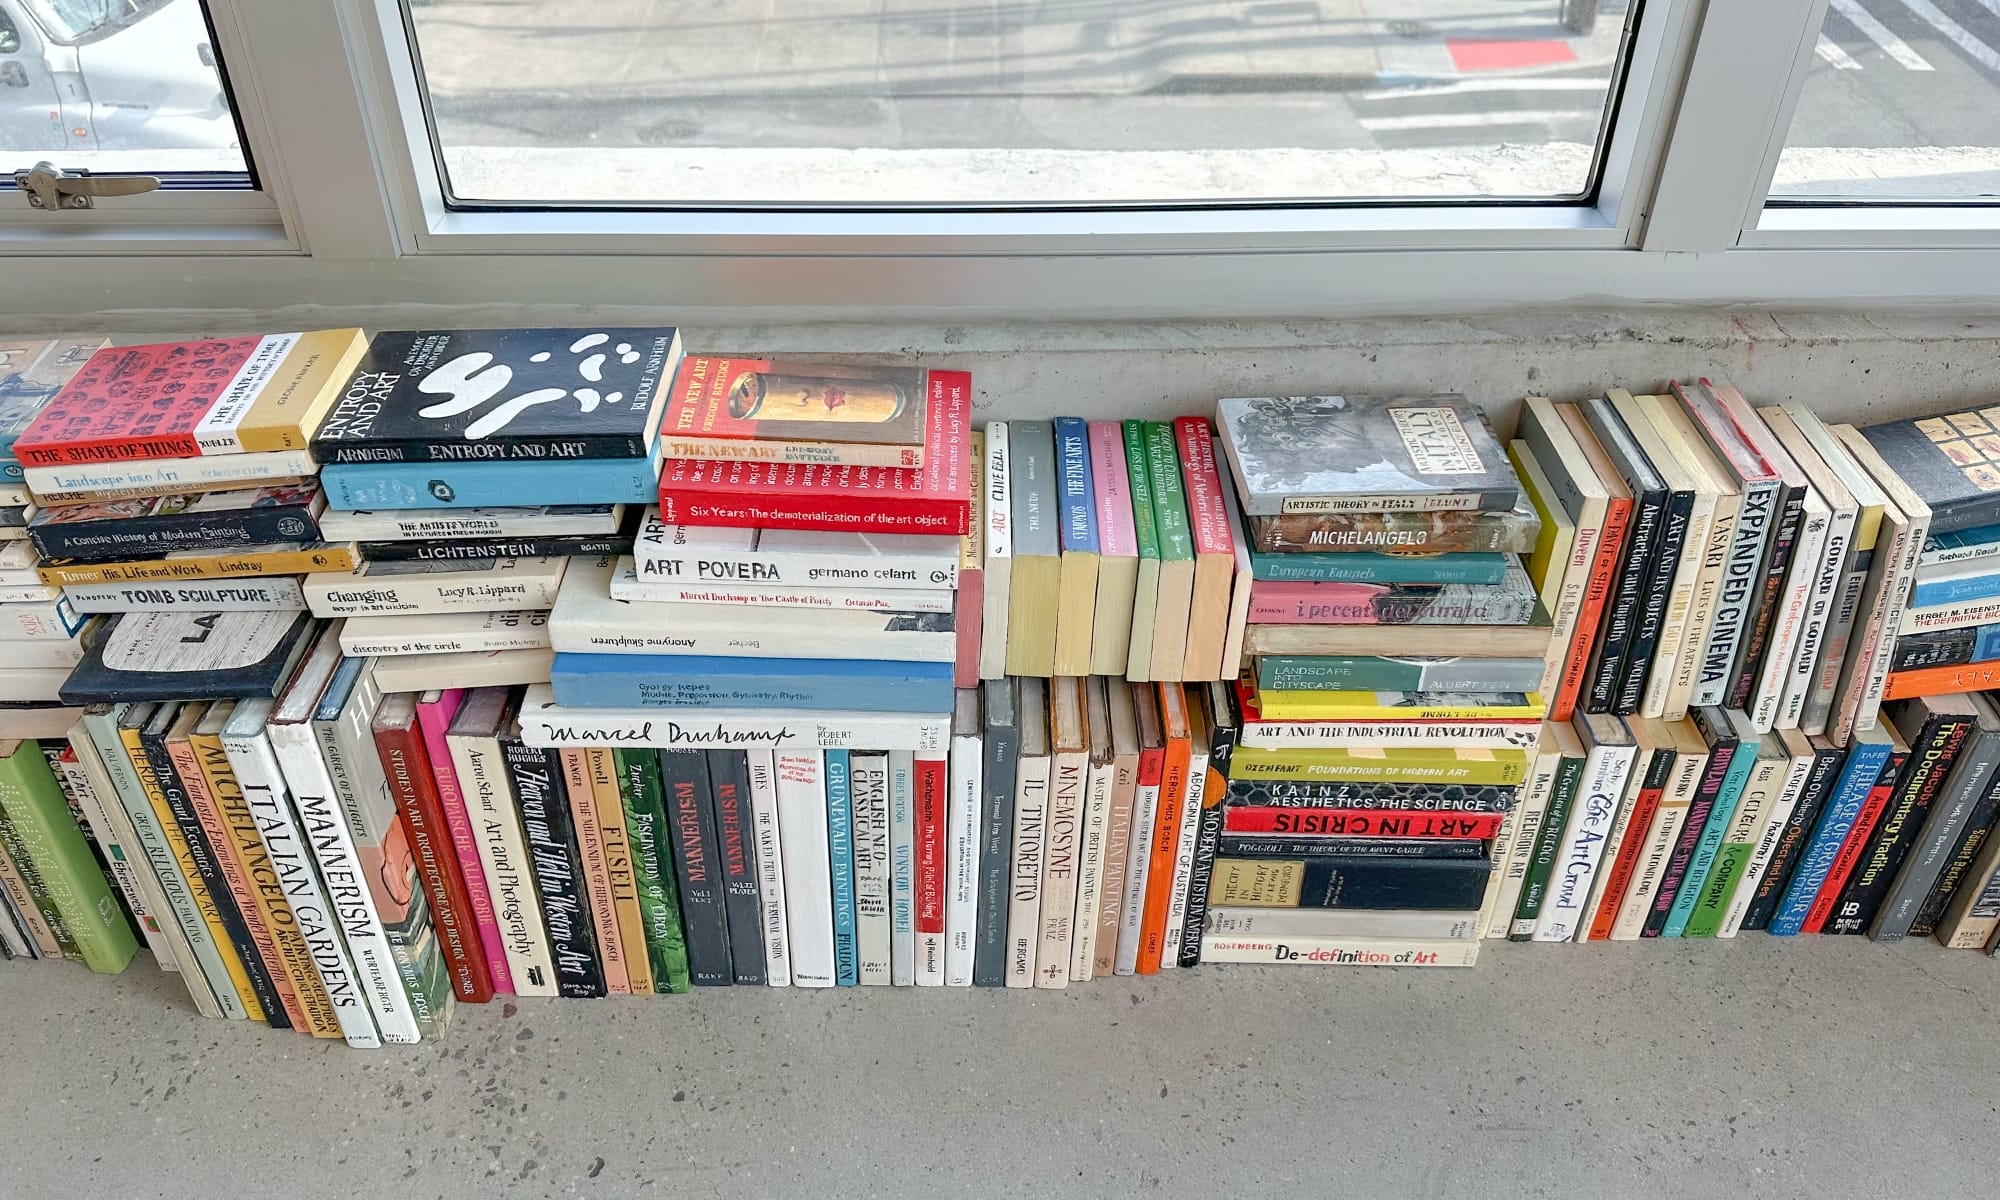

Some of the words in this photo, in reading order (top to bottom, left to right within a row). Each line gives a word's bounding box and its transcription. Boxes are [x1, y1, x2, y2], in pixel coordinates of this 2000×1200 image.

[319, 371, 378, 441] ENTROPY
[348, 400, 384, 438] AND
[377, 371, 401, 401] ART
[26, 449, 64, 464] THE
[69, 444, 118, 461] SHAPE
[118, 442, 139, 457] OF
[137, 439, 194, 456] THINGS
[336, 448, 404, 462] ARNHEIM
[427, 443, 506, 460] ENTROPY
[511, 444, 546, 458] AND
[550, 442, 587, 457] ART
[53, 474, 124, 489] Landscape
[157, 469, 179, 483] Art
[690, 506, 709, 518] Six
[711, 506, 747, 518] Years:
[748, 507, 769, 519] The
[770, 508, 862, 523] dematerialization
[864, 513, 877, 523] of
[877, 513, 895, 524] the
[896, 514, 912, 524] art
[915, 513, 948, 527] object
[1286, 500, 1330, 509] ARTISTIC
[1333, 500, 1370, 509] THEORY
[1381, 499, 1416, 509] ITALY
[1429, 498, 1470, 507] BLUNT
[643, 515, 666, 544] ART
[991, 509, 1006, 536] ART
[1665, 513, 1686, 545] ART
[1778, 500, 1802, 541] FILM
[417, 544, 537, 560] LICHTENSTEIN
[1309, 530, 1428, 546] MICHELANGELO
[1572, 528, 1597, 566] Duveen
[1720, 490, 1772, 604] EXPANDED
[57, 570, 99, 583] Turner
[102, 569, 121, 580] His
[123, 567, 149, 579] Life
[150, 566, 173, 577] and
[171, 563, 204, 576] Work
[218, 561, 263, 574] Lindsay
[643, 559, 684, 575] ART
[698, 560, 781, 580] POVERA
[809, 567, 869, 580] germano
[874, 567, 917, 580] celant
[1659, 546, 1676, 574] AND
[121, 589, 176, 604] TOMB
[178, 588, 271, 603] SCULPTURE
[327, 589, 400, 604] Changing
[438, 586, 466, 599] Lucy
[466, 586, 480, 597] R.
[478, 584, 526, 598] Lippard
[1652, 573, 1667, 594] ITS
[1641, 593, 1664, 641] OBJECTS
[352, 643, 399, 655] discovery
[401, 643, 412, 652] of
[414, 642, 431, 651] the
[434, 640, 462, 651] circle
[590, 635, 645, 648] Skulpturen
[646, 637, 697, 649] Anonyme
[1699, 607, 1742, 684] CINEMA
[1273, 681, 1342, 690] CITYSCAPE
[1274, 667, 1353, 676] LANDSCAPE
[1274, 674, 1303, 682] INTO
[1619, 656, 1647, 710] WOLLHEIM
[541, 721, 653, 742] Marcel
[816, 723, 827, 732] by
[817, 731, 853, 739] ROBERT
[818, 738, 845, 746] LEBEL
[1257, 727, 1283, 738] ART
[1286, 727, 1315, 738] AND
[1319, 727, 1344, 738] THE
[1346, 727, 1422, 738] INDUSTRIAL
[1425, 727, 1510, 739] REVOLUTION
[1930, 721, 1958, 753] The
[1940, 721, 1971, 762] Lewis
[468, 748, 484, 780] Aaron
[1118, 767, 1130, 786] Zeri
[1245, 763, 1303, 773] OZENFANT
[1307, 765, 1383, 775] FOUNDATIONS
[1385, 767, 1400, 776] OF
[1402, 767, 1444, 776] MODERN
[1447, 768, 1470, 777] ART
[1816, 756, 1836, 783] Brian
[1857, 761, 1880, 791] THE
[477, 780, 497, 818] Scharf
[869, 769, 886, 830] ENGLISH
[1023, 779, 1045, 797] IL
[1164, 764, 1180, 822] HIERONYMUS
[1184, 770, 1203, 831] ABORIGINAL
[1883, 750, 1943, 836] Documentary
[1916, 763, 1948, 809] Jacobs
[1270, 797, 1373, 808] AESTHETICS
[1380, 798, 1410, 810] THE
[1414, 798, 1487, 811] SCIENCE
[1791, 784, 1822, 830] O'Doherty
[1838, 790, 1862, 821] AGE
[156, 763, 172, 785] The
[166, 788, 192, 822] Grand
[182, 822, 214, 879] Eccentrics
[199, 743, 294, 927] MICHELANGELO
[484, 817, 504, 844] Art
[591, 749, 609, 785] Powell
[602, 825, 634, 902] FUSELI
[673, 780, 707, 883] MANNERISM
[719, 782, 745, 877] MANNERISM
[1050, 765, 1080, 880] MNEMOSYNE
[1109, 805, 1130, 859] ITALIAN
[1197, 809, 1220, 862] MODERN
[1272, 813, 1370, 835] CRISIS
[1379, 818, 1409, 835] IN
[1419, 818, 1479, 836] ART
[1515, 809, 1541, 858] RELIGIOUS
[1832, 821, 1851, 839] OF
[872, 832, 887, 868] NEO-
[1014, 804, 1043, 902] TINTORETTO
[1160, 825, 1172, 853] BOSCH
[1183, 833, 1194, 853] ART
[1704, 827, 1721, 849] ART
[1780, 825, 1803, 860] Object
[299, 795, 377, 938] MANNERISM
[495, 846, 511, 872] and
[895, 843, 910, 894] WINSLOW
[1180, 854, 1192, 869] OF
[1506, 860, 1526, 880] ART
[1696, 848, 1714, 870] AND
[1769, 857, 1785, 877] and
[1859, 834, 1900, 887] Tradition
[5, 876, 28, 907] Indian
[112, 861, 146, 918] Ehrenzweig
[1190, 861, 1212, 906] ARTISTS
[1250, 865, 1269, 902] HISTORY
[1679, 869, 1705, 910] RELIGION
[1758, 876, 1777, 898] Idea
[1792, 840, 1841, 914] GRANDEUR
[243, 783, 315, 898] ITALIAN
[295, 905, 358, 1008] GARDENS
[834, 862, 851, 927] PAINTINGS
[1102, 861, 1123, 928] PAINTINGS
[1171, 869, 1189, 918] AUSTRALIA
[498, 873, 535, 958] Photography
[895, 898, 909, 934] HOMER
[1182, 918, 1205, 960] AMERICA
[1213, 943, 1273, 951] ROSENBERG
[1275, 944, 1390, 963] De-definition
[1394, 950, 1413, 963] of
[1412, 951, 1440, 964] Art
[837, 933, 853, 981] PHAIDON
[1015, 937, 1028, 976] BERGAMO
